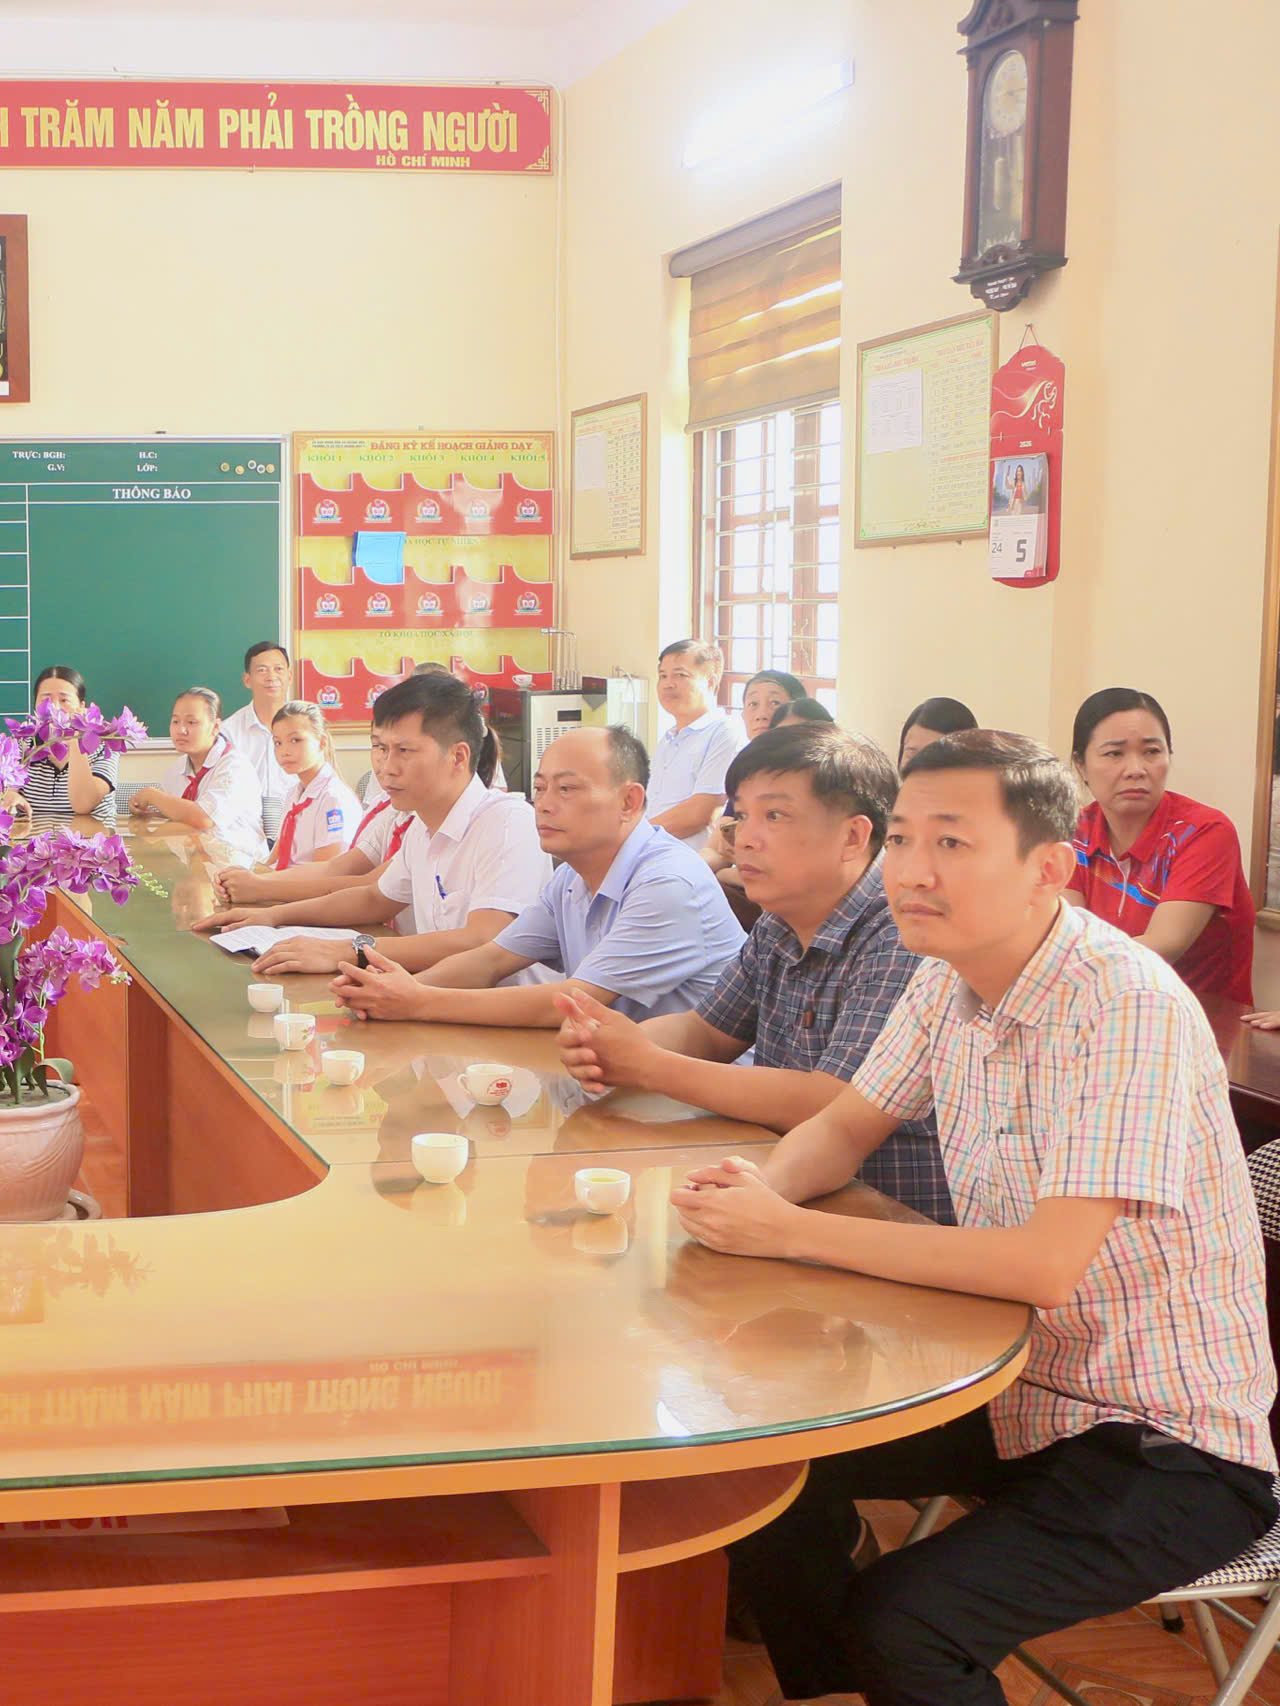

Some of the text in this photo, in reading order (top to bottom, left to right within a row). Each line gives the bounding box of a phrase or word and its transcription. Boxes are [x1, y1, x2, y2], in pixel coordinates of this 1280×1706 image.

[20, 99, 116, 149] TRĂM
[128, 99, 205, 149] NĂM
[218, 91, 294, 150] PHẢI
[305, 93, 410, 153] TRỒNG
[421, 100, 520, 154] NGƯỜI
[375, 152, 472, 169] HỒ CHÍ MINH
[43, 451, 66, 460] BGH:
[138, 451, 158, 460] H.C:
[47, 463, 65, 472] G.V:
[112, 485, 192, 501] THÔNG BÁO
[991, 542, 1003, 554] 24
[1015, 539, 1027, 563] 5
